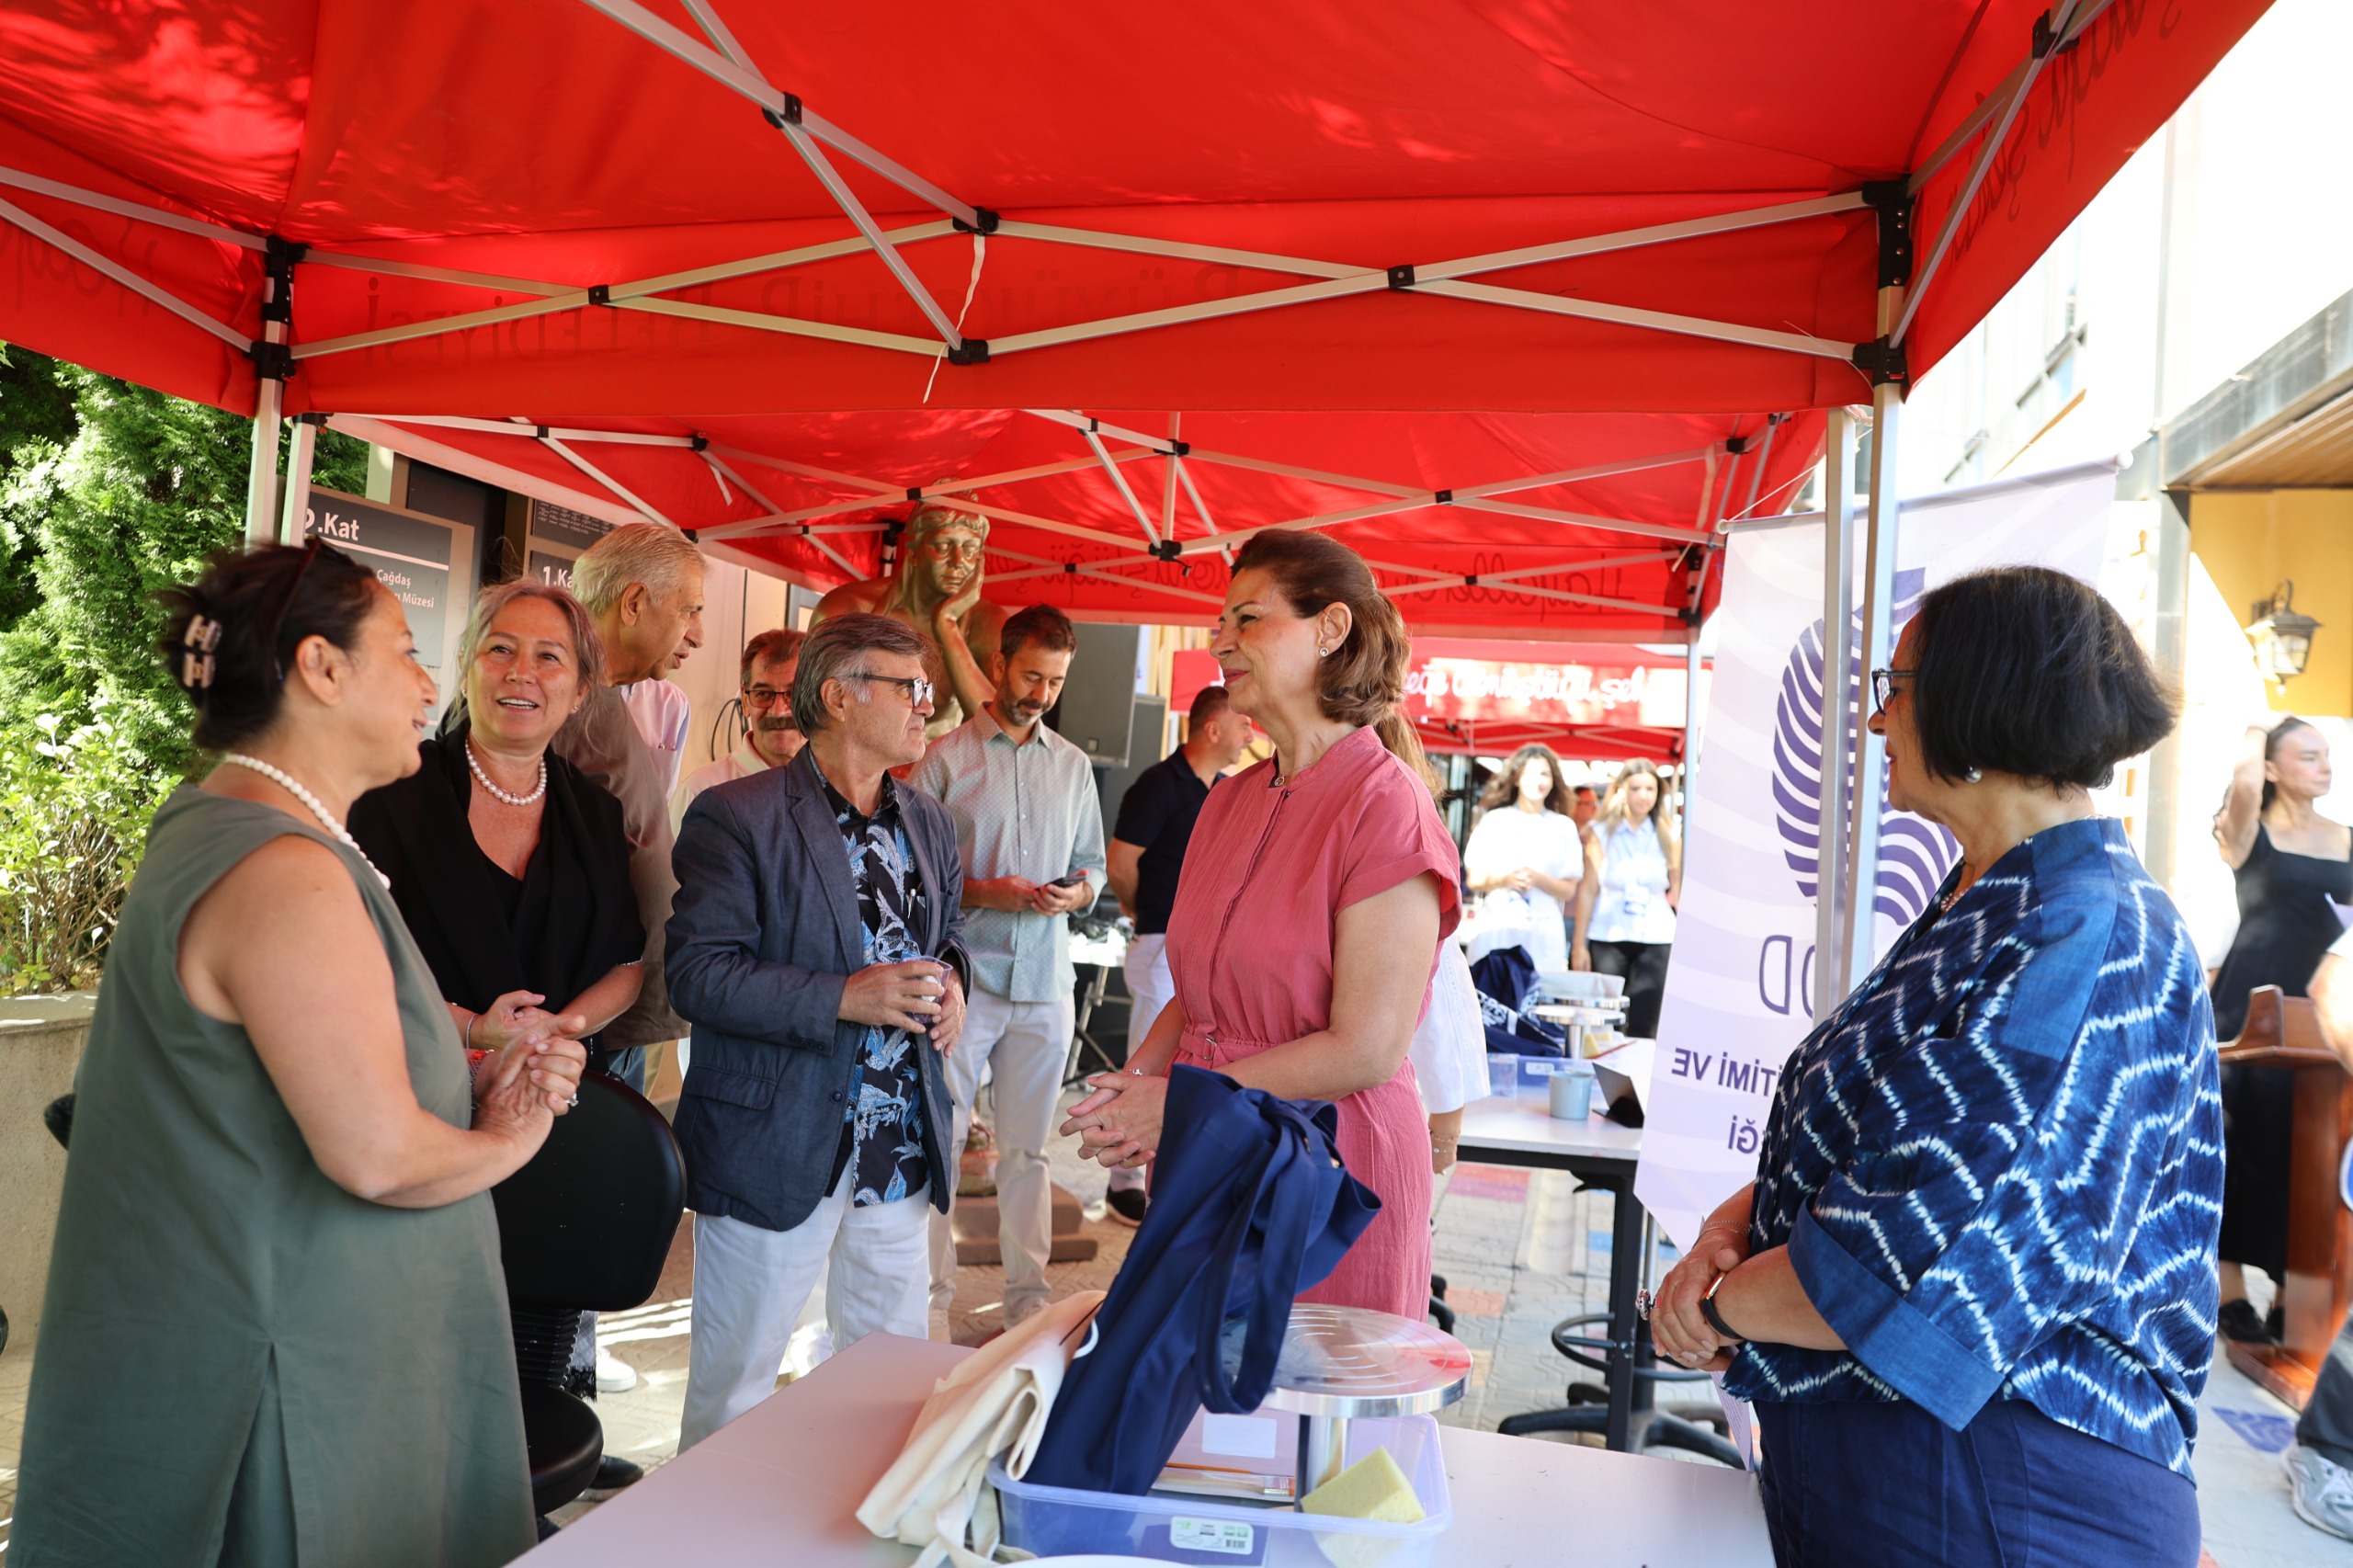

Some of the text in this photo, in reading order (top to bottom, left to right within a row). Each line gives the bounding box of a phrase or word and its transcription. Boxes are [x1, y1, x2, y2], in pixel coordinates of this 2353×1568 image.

[377, 569, 411, 589] Çağdaş
[543, 565, 573, 589] 1.Ka
[403, 592, 435, 608] Müzesi
